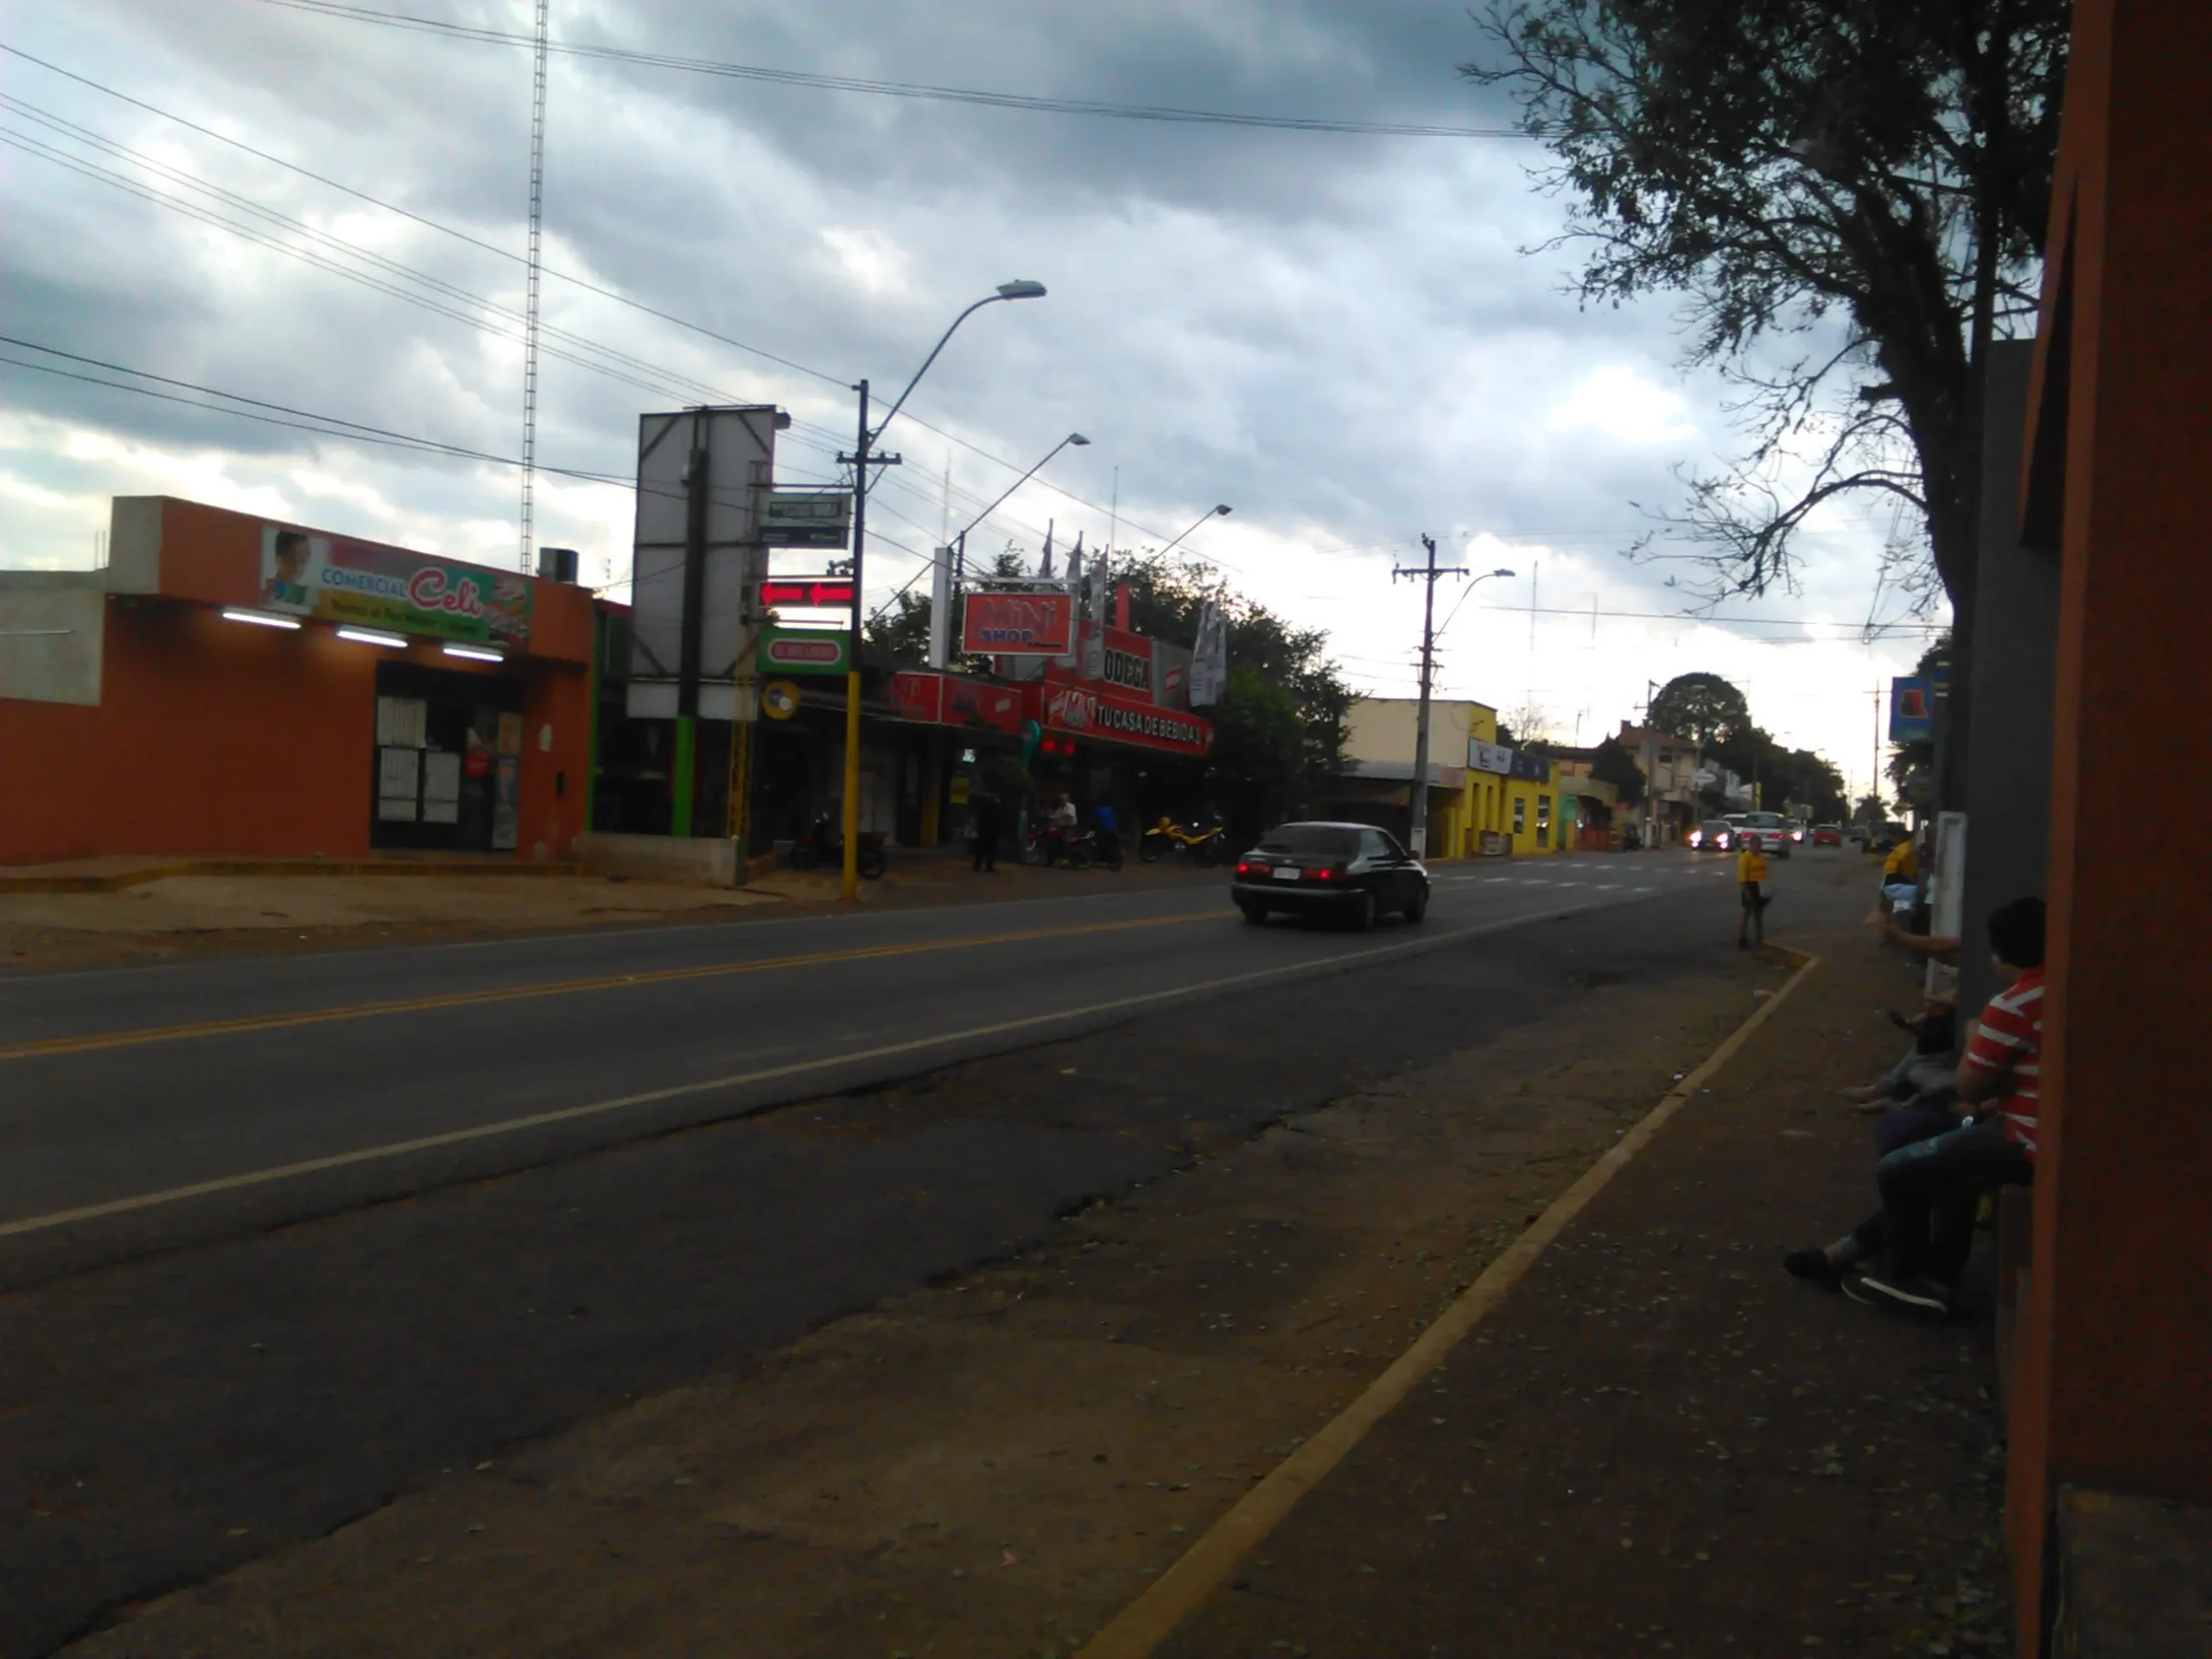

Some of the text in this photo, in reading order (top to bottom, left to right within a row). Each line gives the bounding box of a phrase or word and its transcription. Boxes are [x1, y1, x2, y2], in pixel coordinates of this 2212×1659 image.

[321, 567, 485, 616] COMERCIAL Celi
[981, 628, 1033, 644] SHOP
[1103, 647, 1150, 692] ODEGA
[1097, 706, 1112, 727] TU
[1113, 709, 1142, 734] CASA
[1144, 715, 1159, 735] DE
[1160, 719, 1201, 745] BEBIDAS
